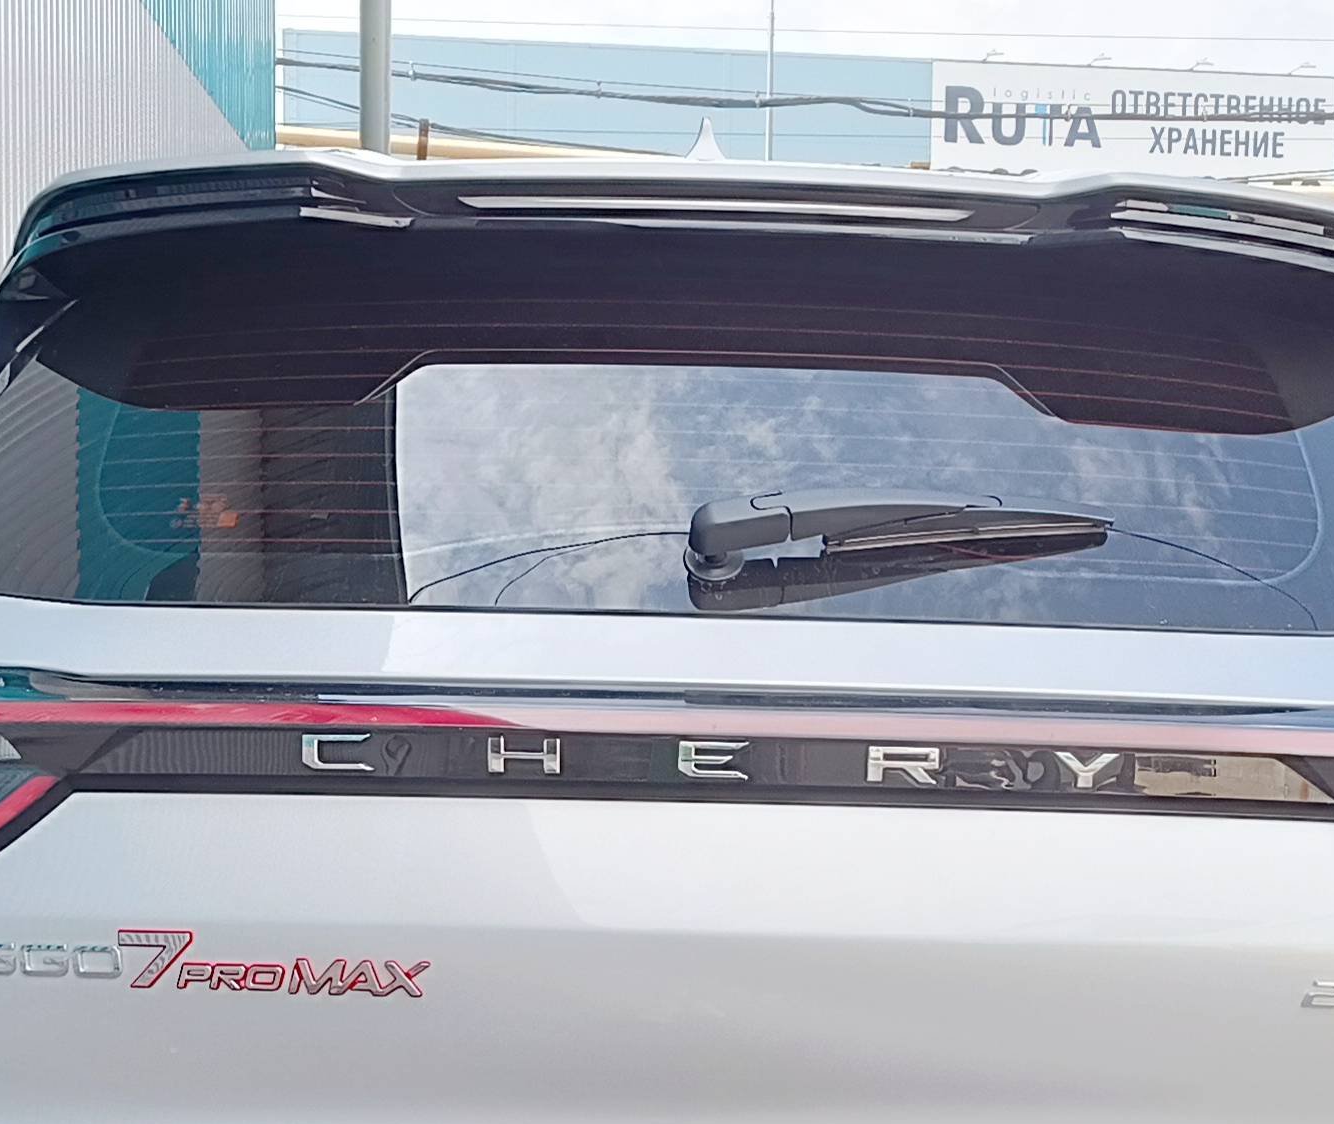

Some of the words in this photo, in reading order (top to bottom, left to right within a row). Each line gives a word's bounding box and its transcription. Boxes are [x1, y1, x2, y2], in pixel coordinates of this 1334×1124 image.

[993, 87, 1091, 100] logistic
[1111, 89, 1326, 126] ОТВЕТСТВЕННОЕ
[1148, 126, 1285, 158] ХРАНЕНИЕ
[300, 731, 1119, 789] CHERY
